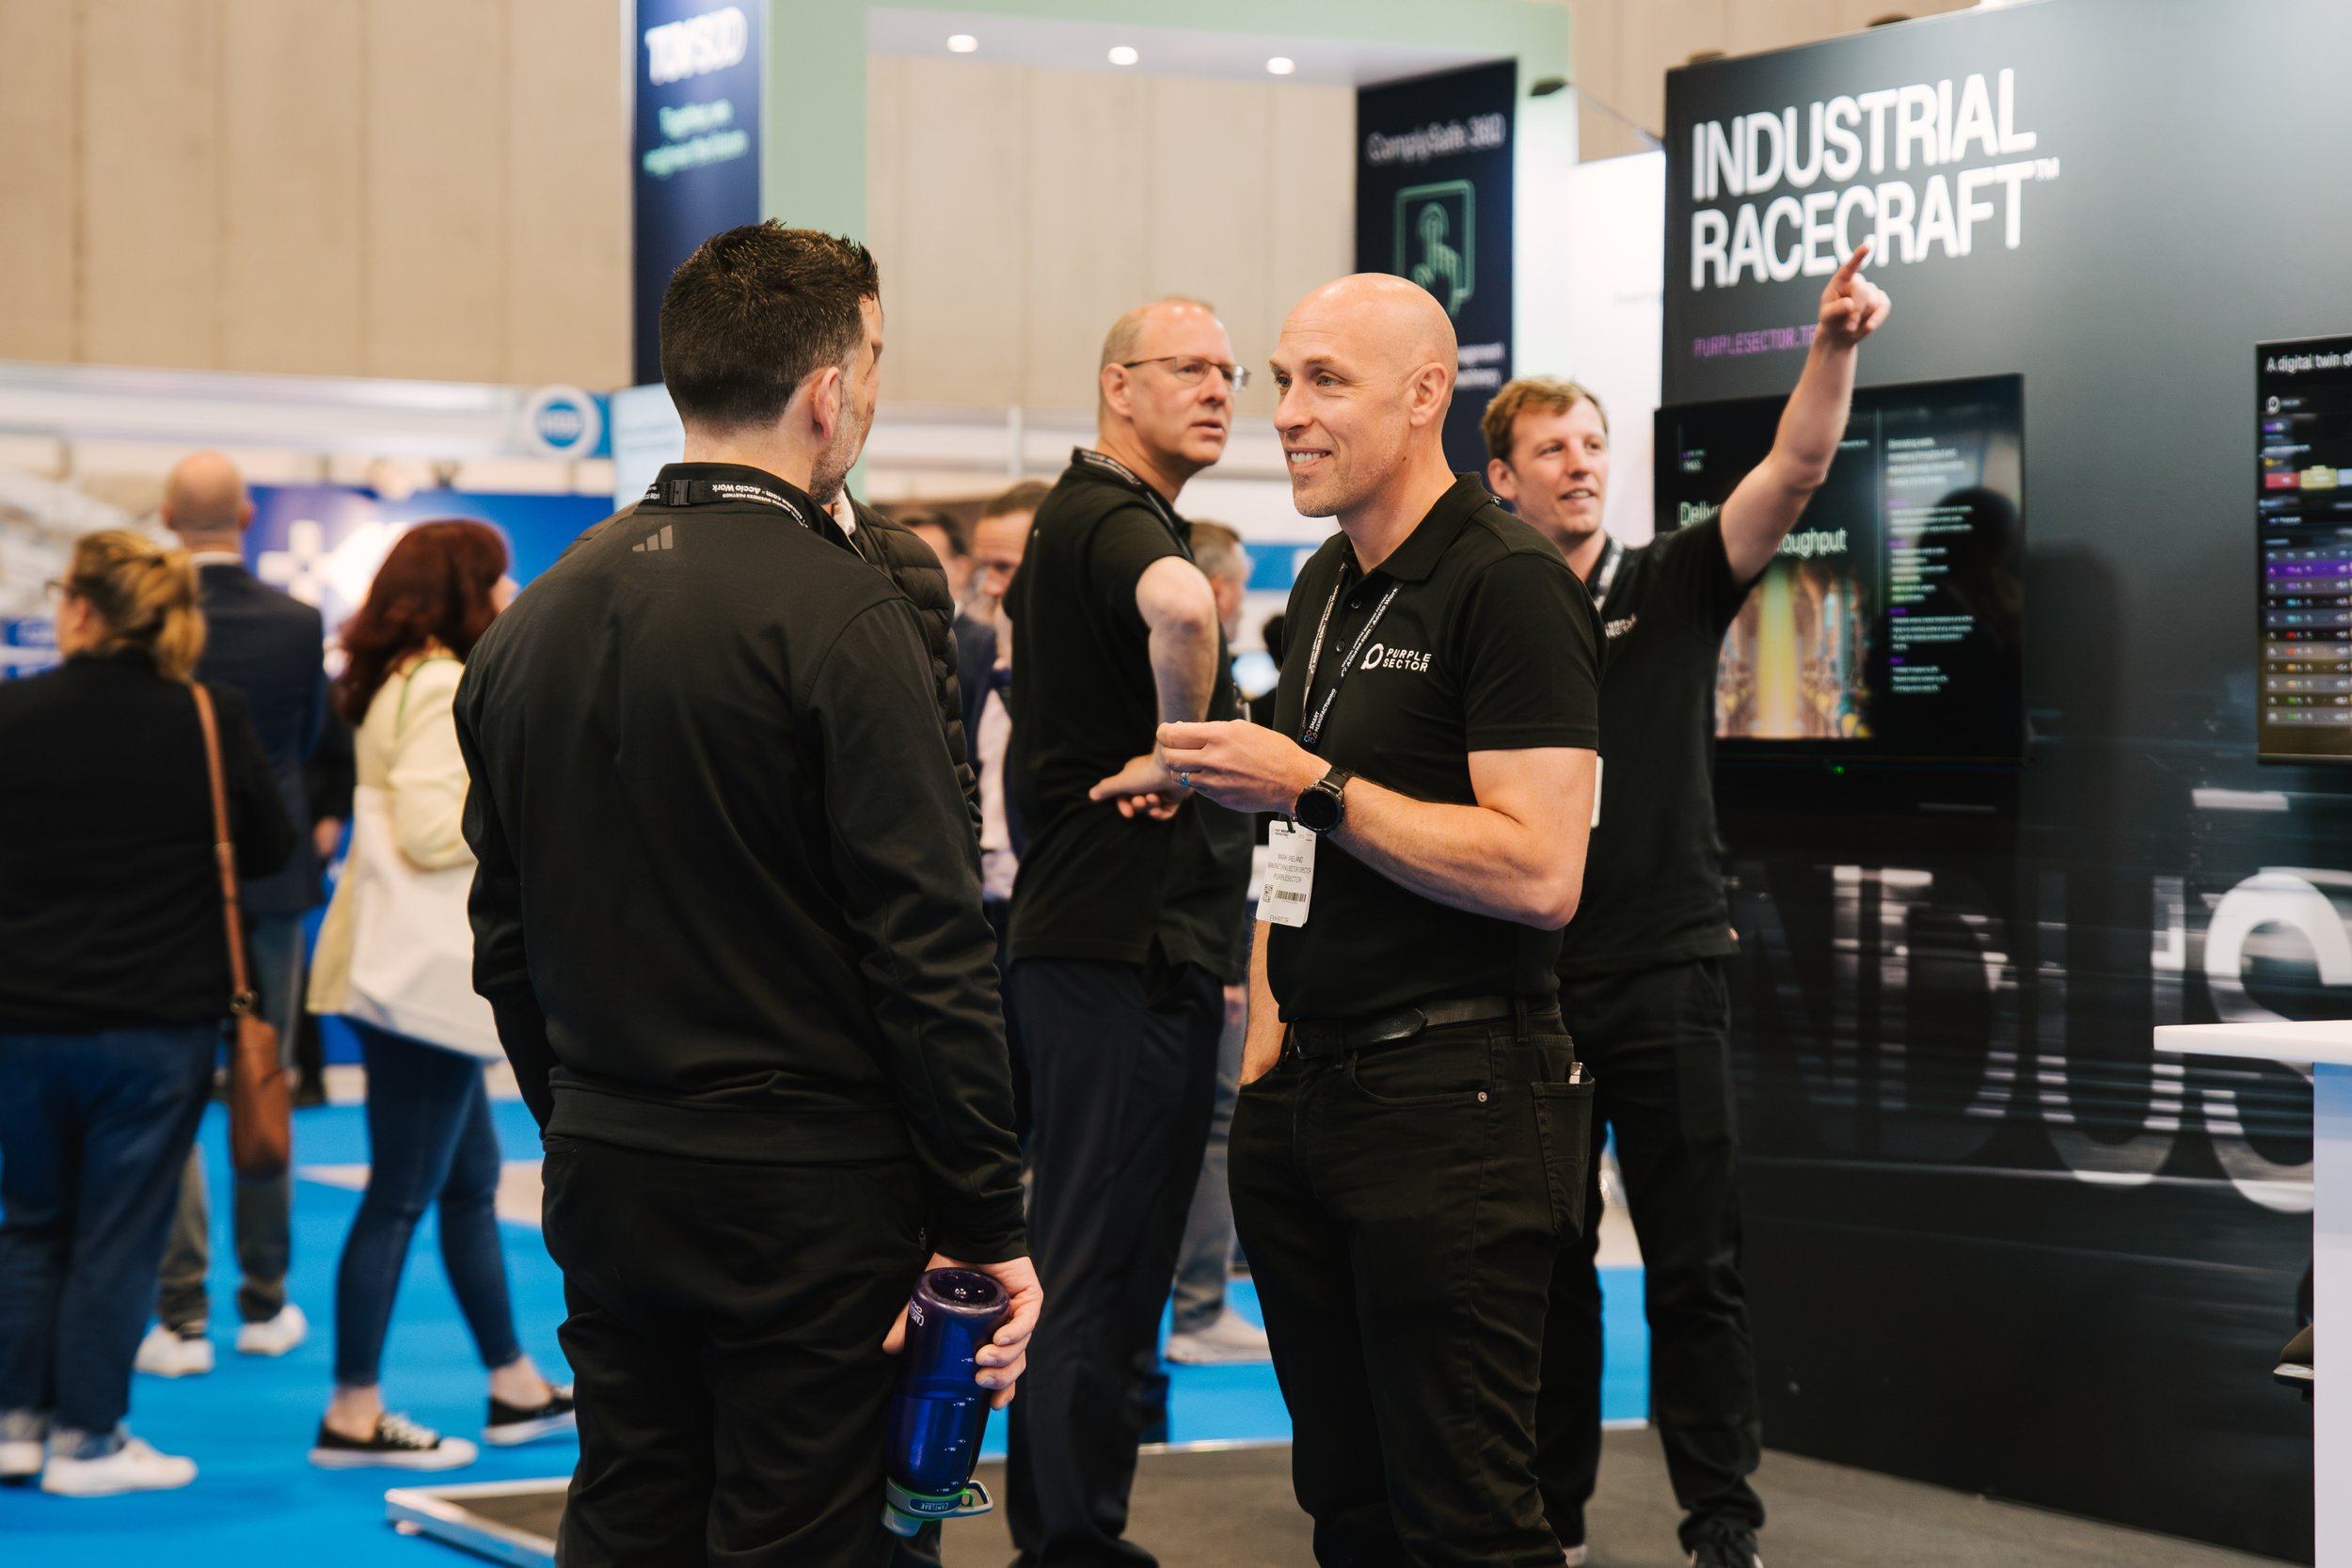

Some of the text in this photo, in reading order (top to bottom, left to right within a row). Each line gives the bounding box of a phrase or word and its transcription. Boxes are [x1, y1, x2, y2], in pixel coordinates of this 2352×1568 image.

[1692, 68, 2037, 201] INDUSTRIAL
[2266, 356, 2276, 372] A
[2278, 355, 2312, 374] digital
[712, 483, 734, 492] Work
[736, 483, 761, 494] Accio
[1383, 587, 1398, 605] Work
[1387, 648, 1432, 662] PURPLE
[1383, 658, 1428, 673] SECTOR
[1314, 688, 1336, 733] MANUFACTURING
[1309, 710, 1320, 730] SMART
